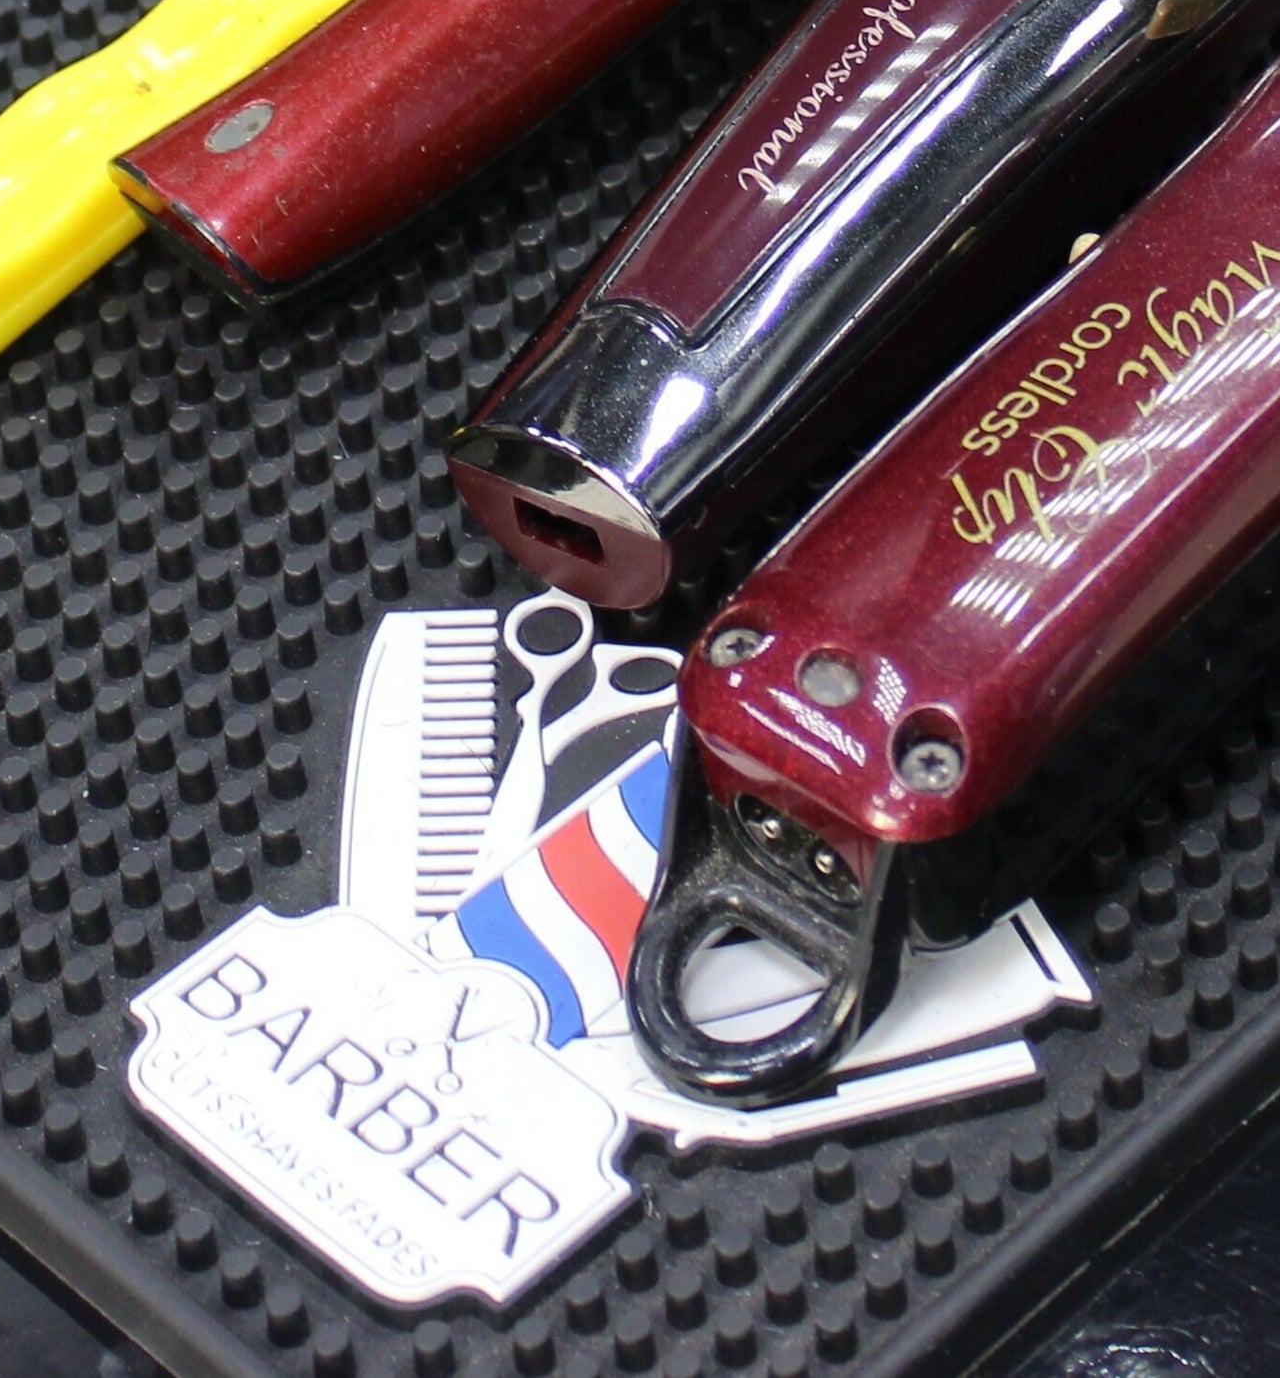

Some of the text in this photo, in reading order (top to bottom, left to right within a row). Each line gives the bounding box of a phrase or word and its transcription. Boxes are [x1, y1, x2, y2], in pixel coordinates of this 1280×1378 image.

[961, 302, 1132, 457] cordless
[951, 426, 1152, 544] Clip
[179, 953, 561, 1259] BARBER
